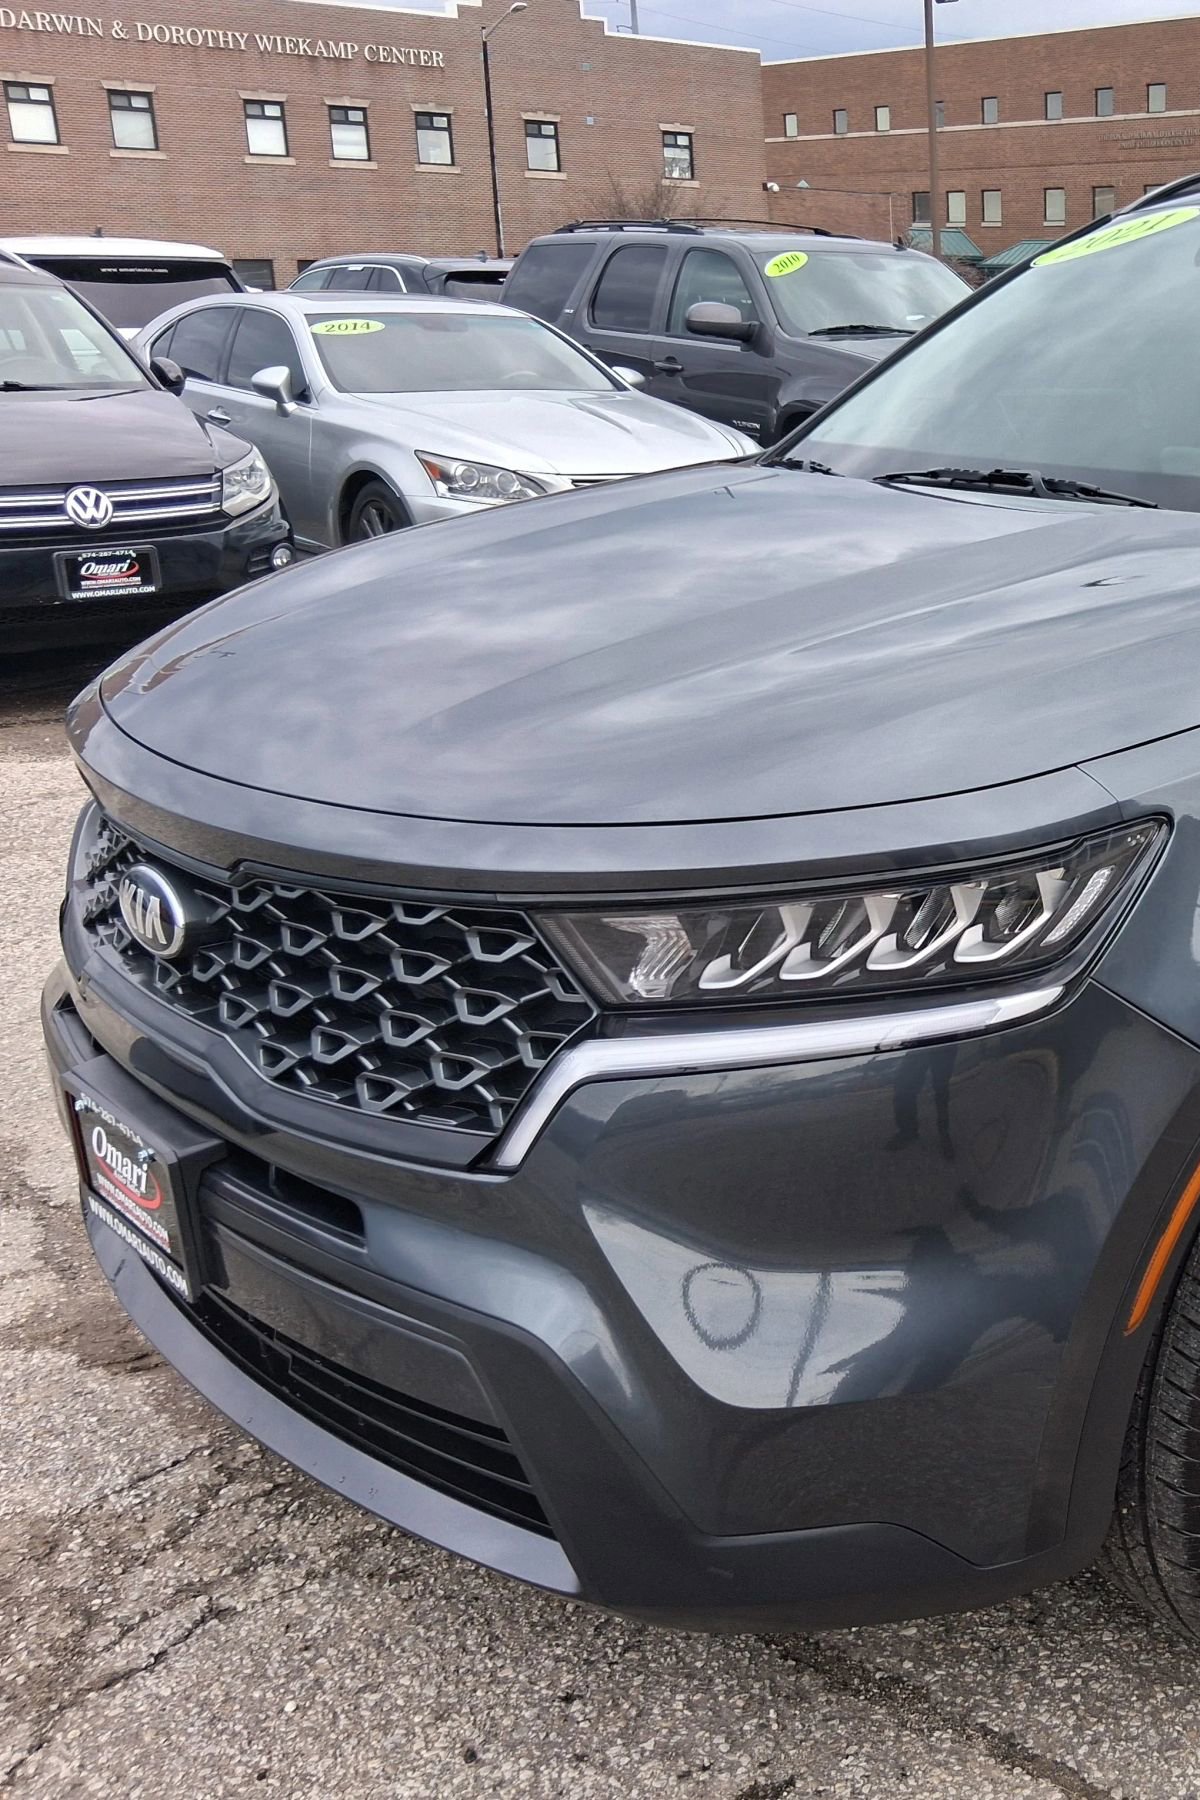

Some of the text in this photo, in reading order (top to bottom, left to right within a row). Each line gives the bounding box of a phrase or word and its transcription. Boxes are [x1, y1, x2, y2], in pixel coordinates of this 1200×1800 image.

[0, 8, 446, 69] DARWIN & DOROTHY WIEKAMP CENTER
[773, 253, 801, 273] 2010
[324, 321, 371, 333] 2014
[80, 559, 131, 576] Omari
[71, 586, 156, 600] WWW.OMARIAUTO.COM
[120, 878, 168, 945] KIA
[91, 1126, 149, 1194] Omari
[88, 1196, 189, 1297] WWW.OMARIAUTO.COM
